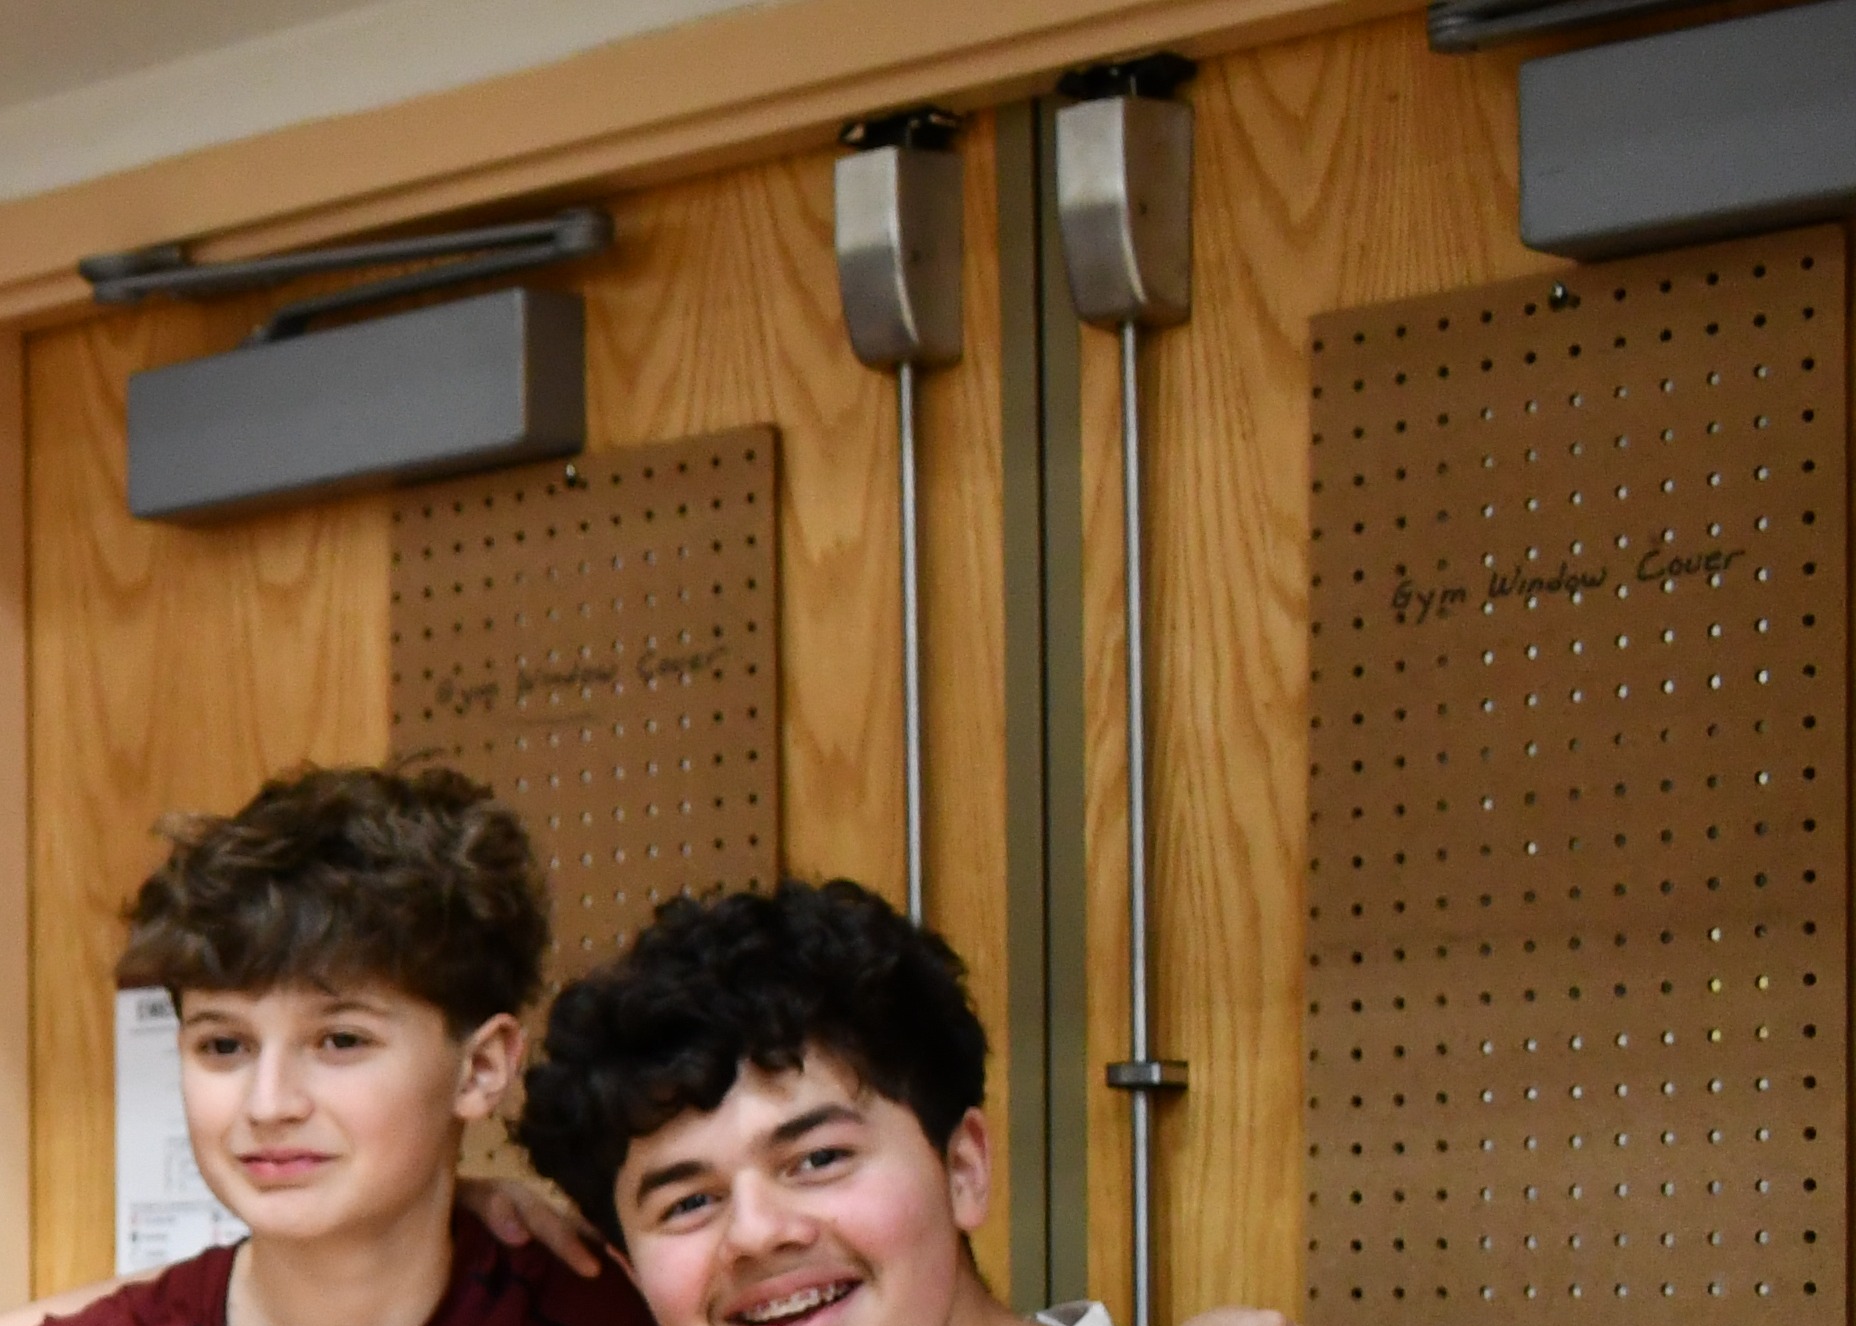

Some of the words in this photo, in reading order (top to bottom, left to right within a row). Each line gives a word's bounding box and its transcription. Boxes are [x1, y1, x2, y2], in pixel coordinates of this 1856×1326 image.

[1393, 579, 1467, 624] Gym
[1488, 561, 1608, 597] Window
[1636, 547, 1746, 582] Cover
